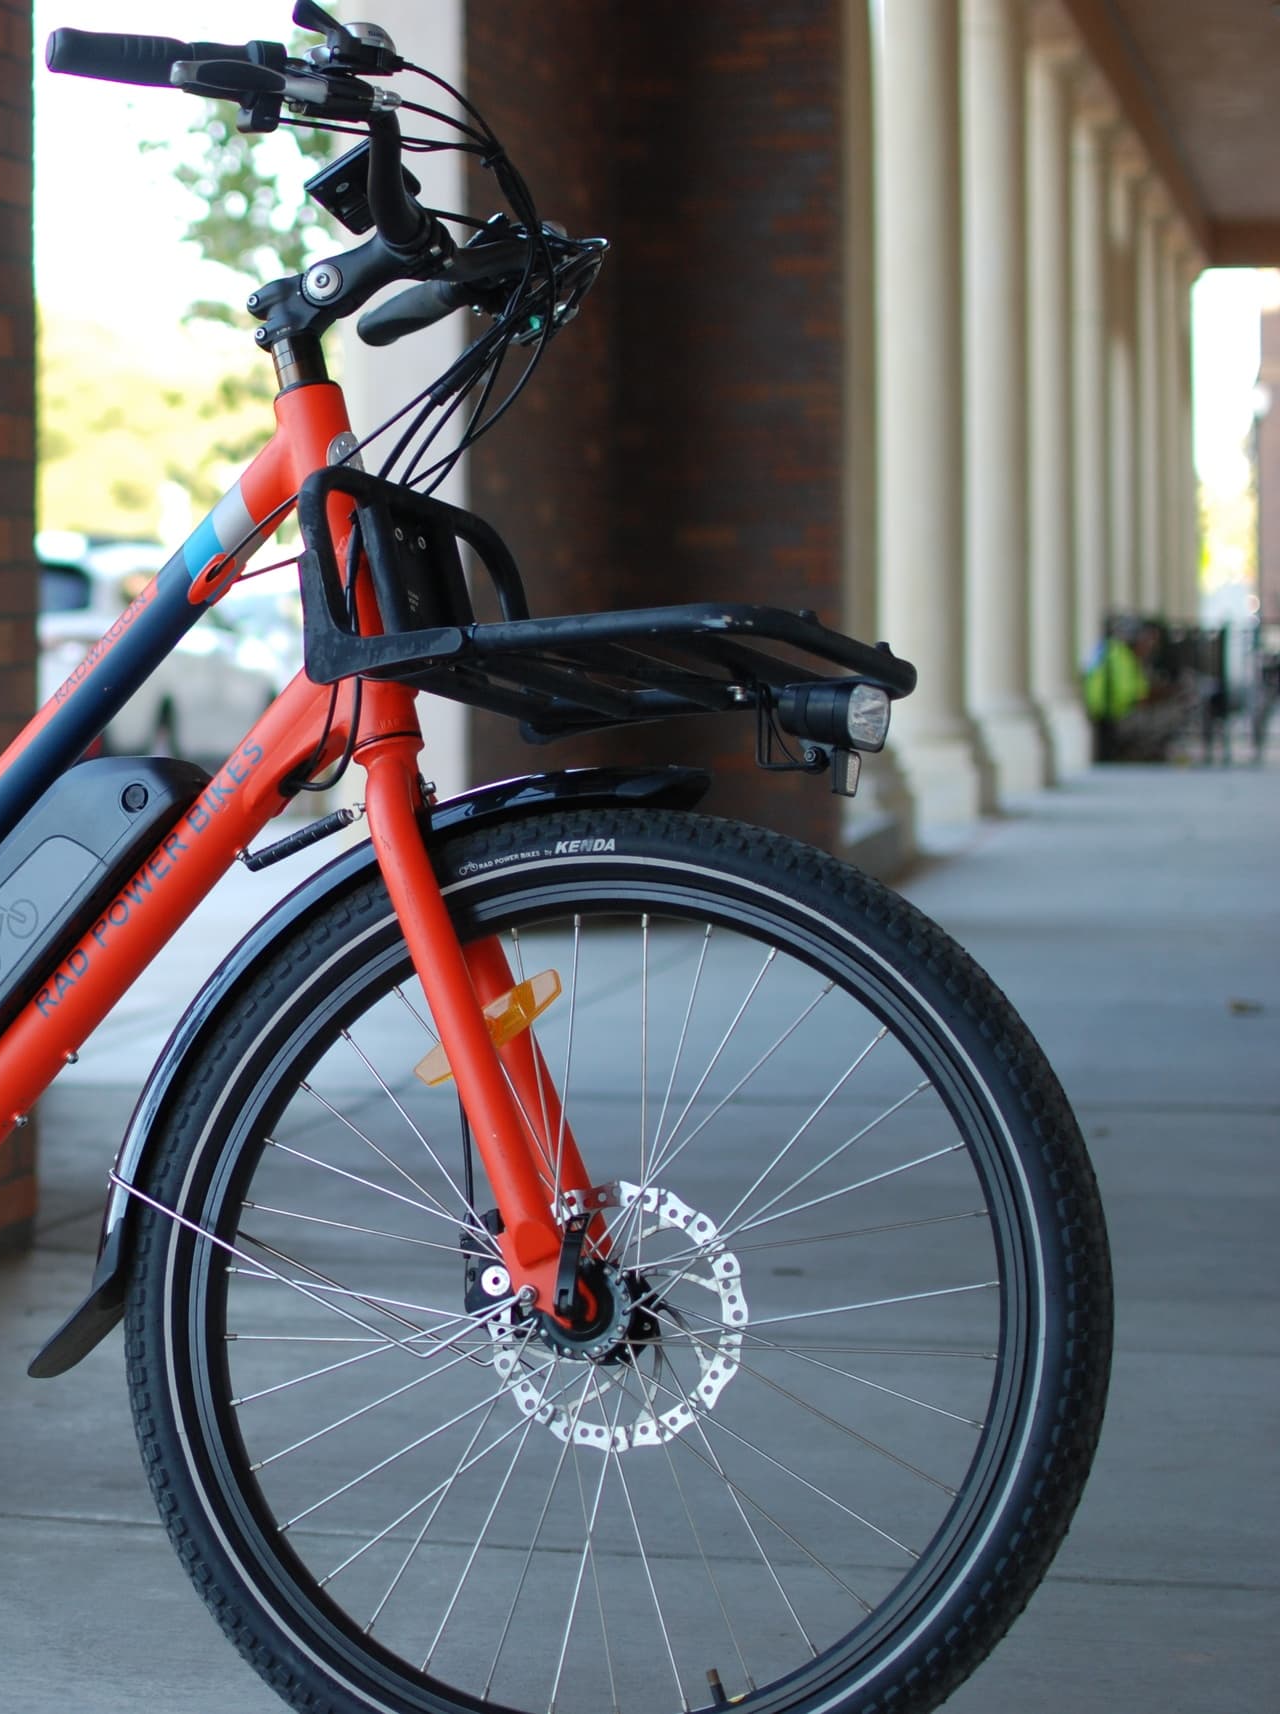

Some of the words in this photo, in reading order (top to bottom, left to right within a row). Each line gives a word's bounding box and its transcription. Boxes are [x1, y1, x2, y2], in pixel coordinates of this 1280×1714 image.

[53, 591, 148, 704] RADWAGON
[34, 947, 90, 1018] RAD
[91, 831, 189, 948] POWER
[186, 737, 265, 834] BIKES
[478, 862, 494, 870] RAD
[494, 853, 519, 865] POWER
[520, 850, 540, 858] BIKES
[554, 838, 616, 855] KENDA
